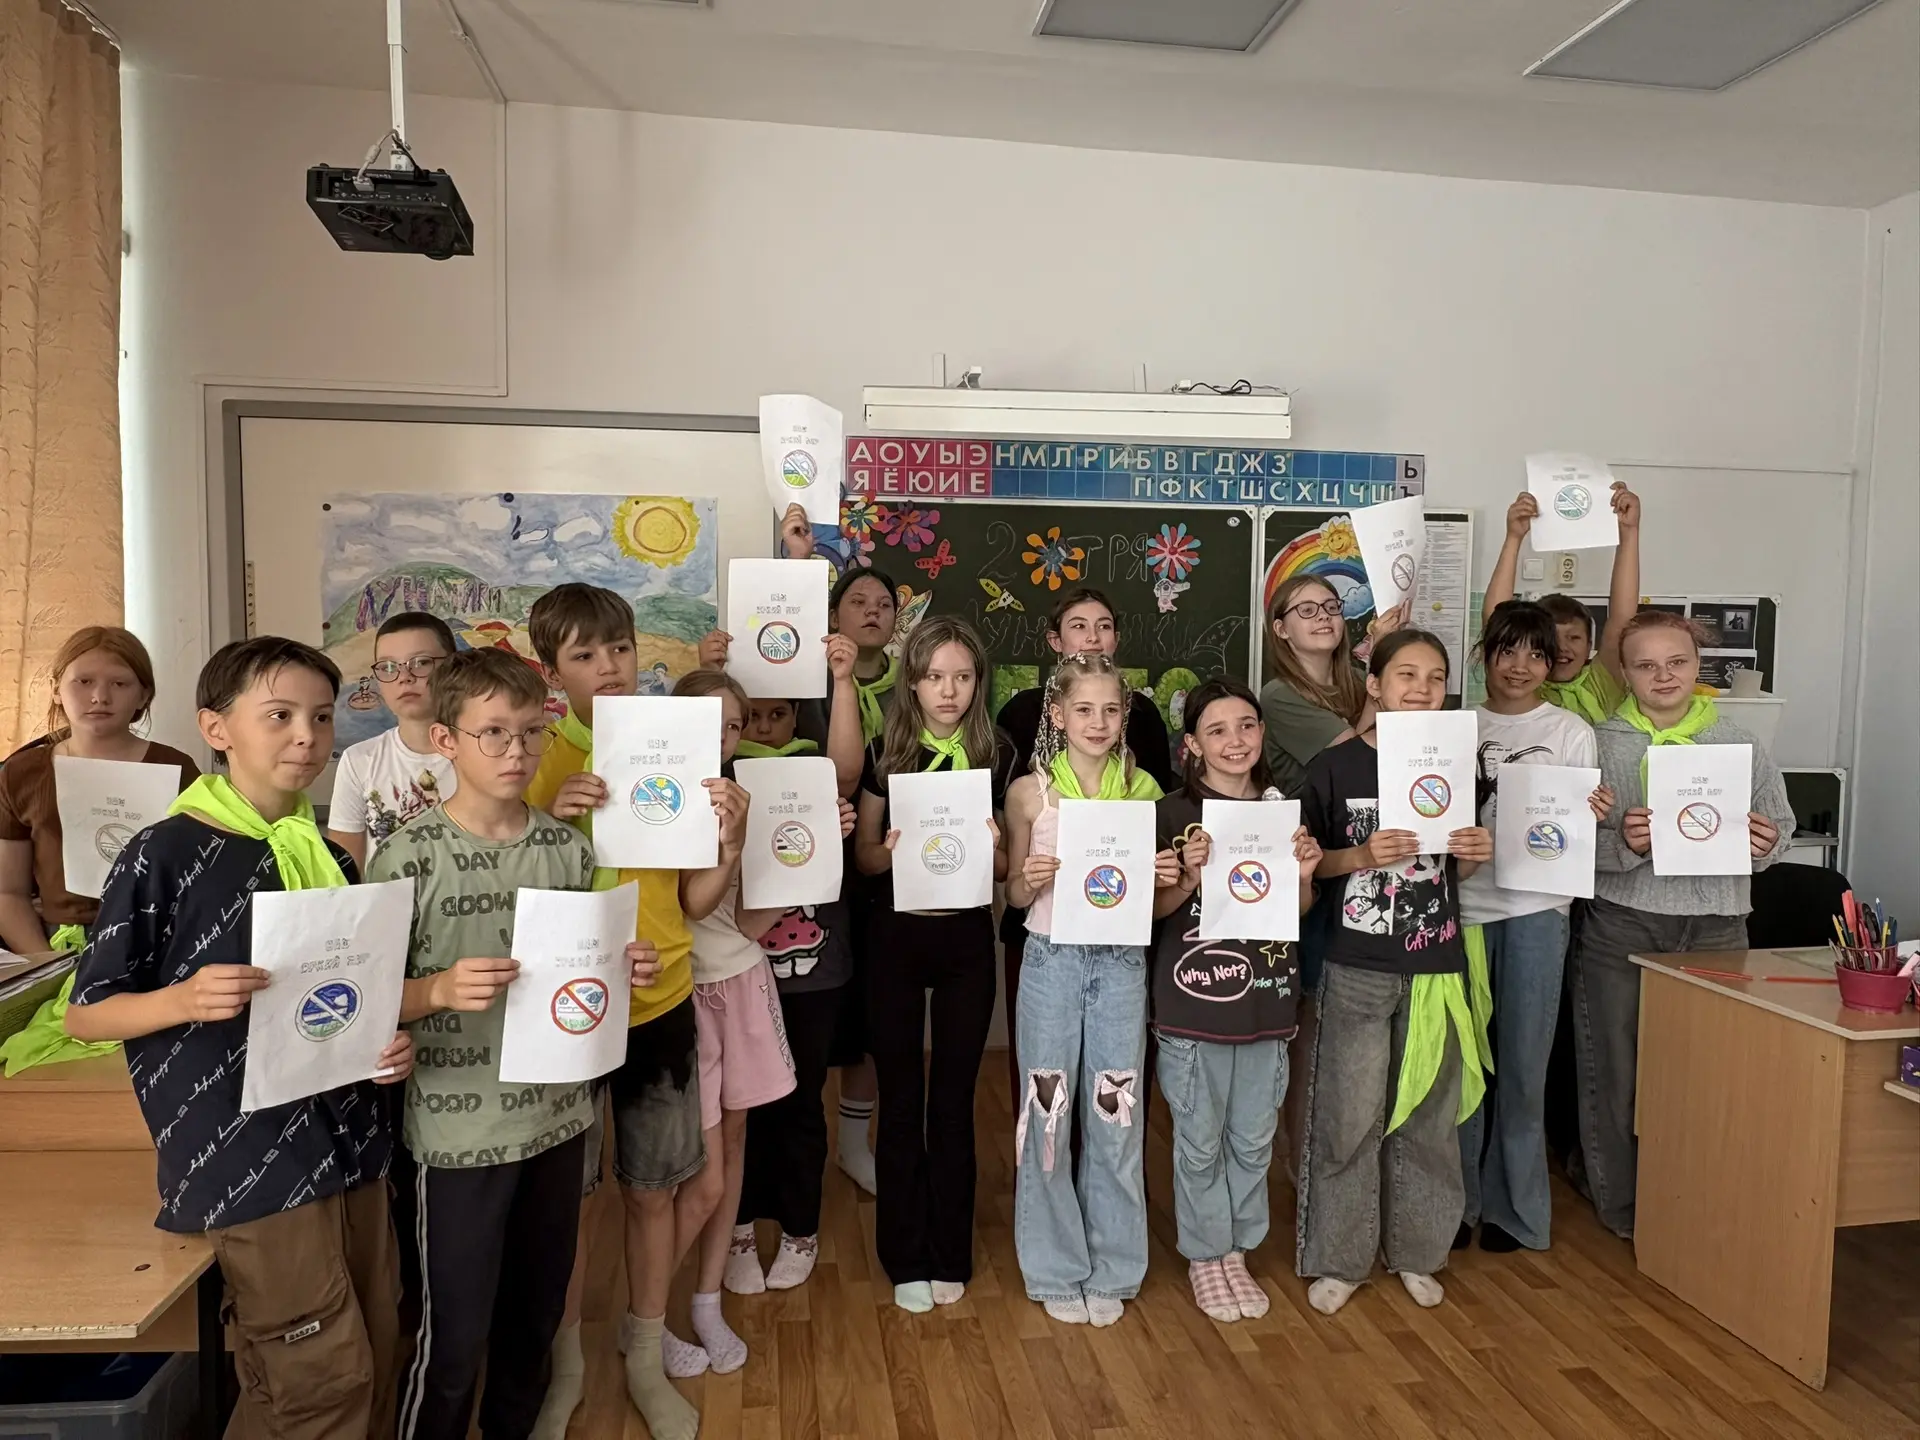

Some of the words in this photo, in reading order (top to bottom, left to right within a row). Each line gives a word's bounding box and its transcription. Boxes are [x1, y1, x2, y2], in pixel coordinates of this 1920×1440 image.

[453, 851, 500, 872] DAY
[1180, 968, 1211, 986] Why
[1213, 963, 1247, 981] Not?
